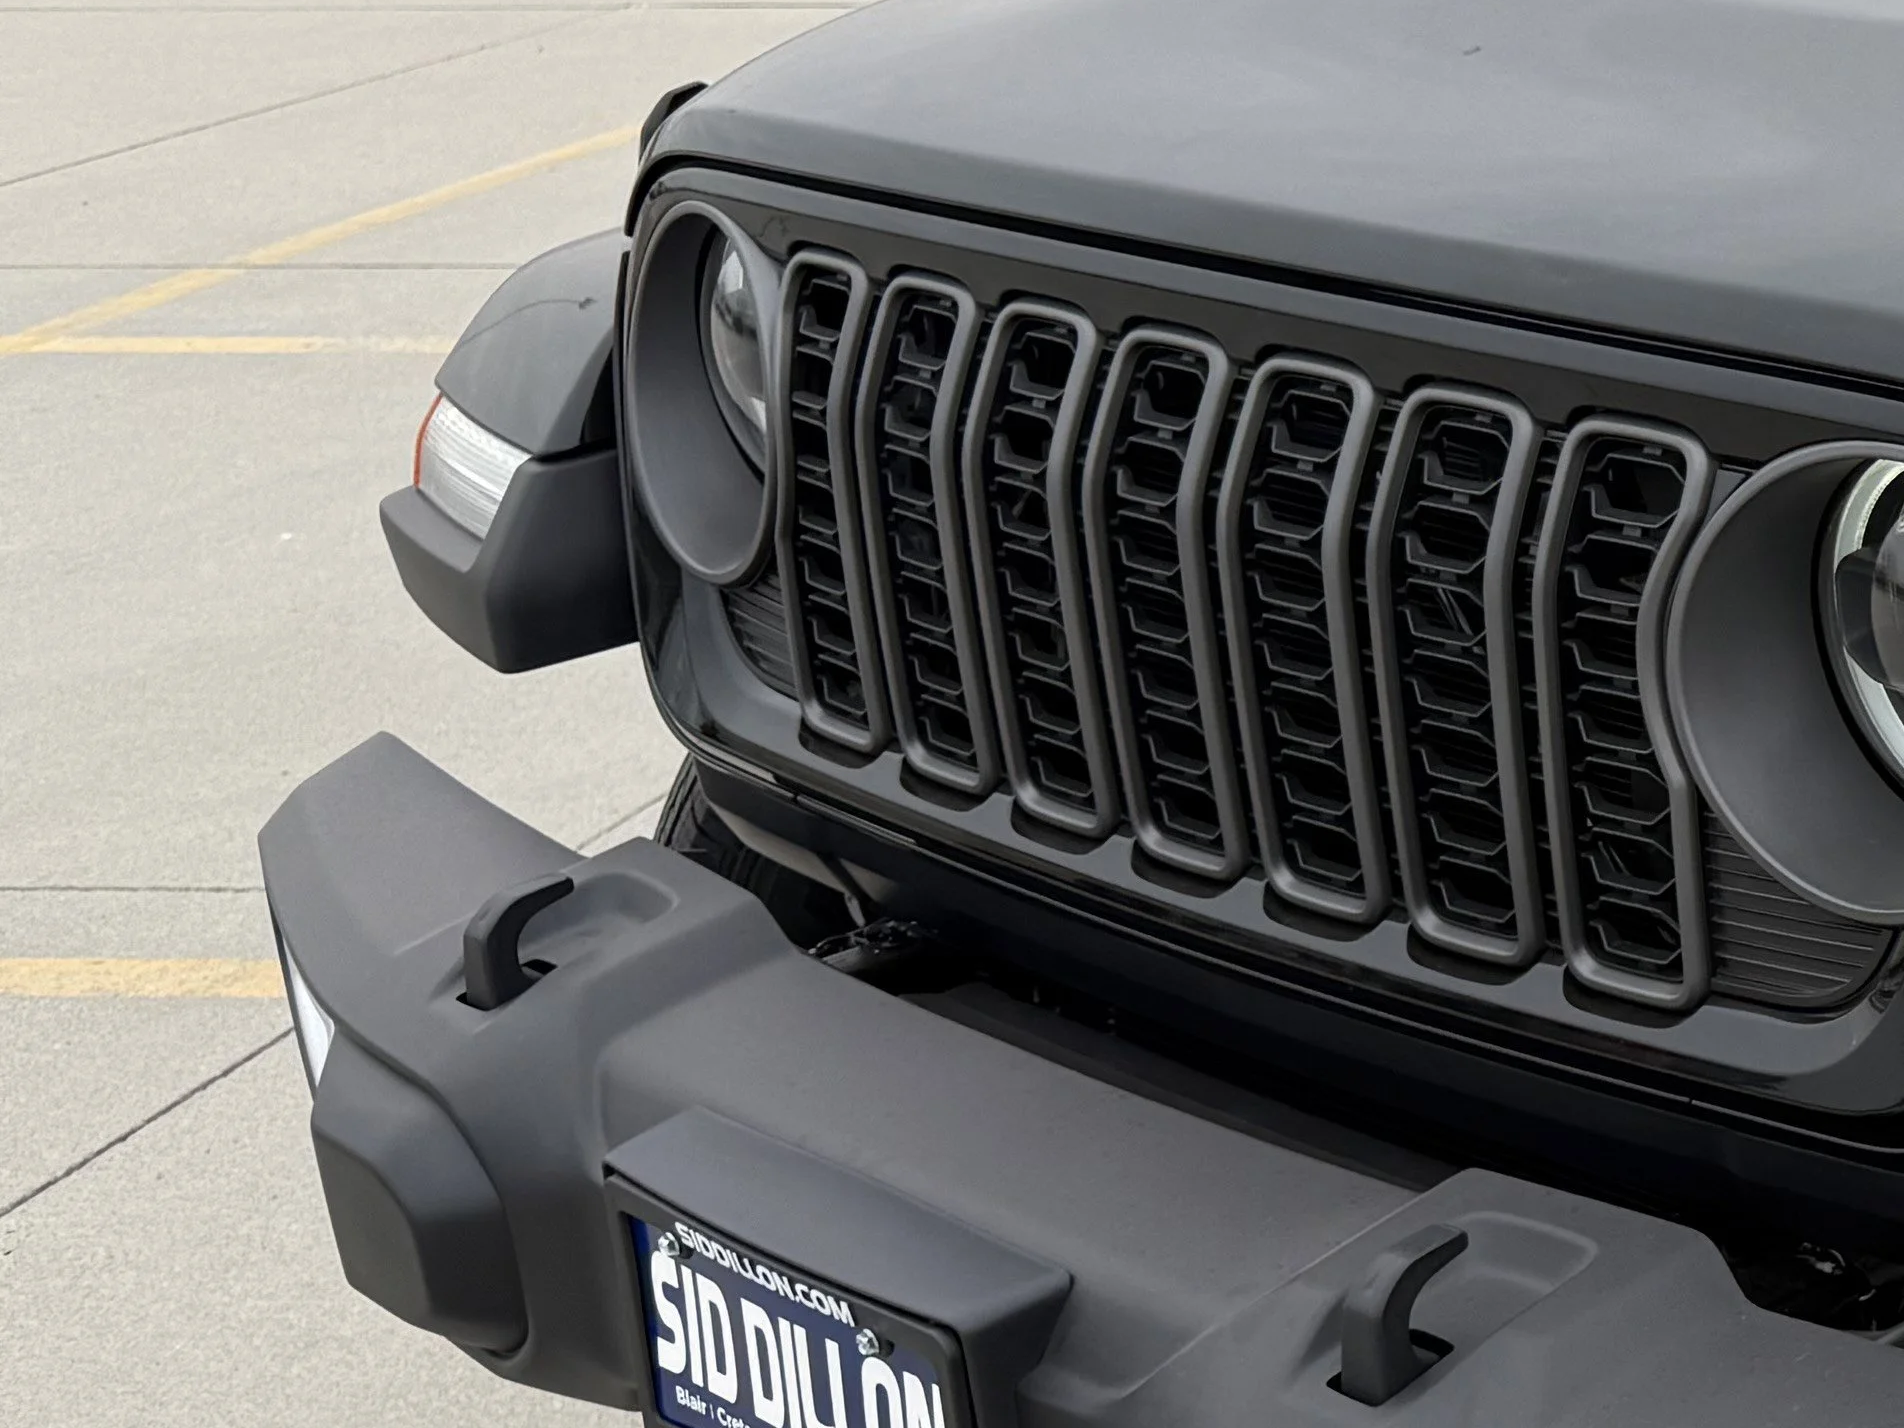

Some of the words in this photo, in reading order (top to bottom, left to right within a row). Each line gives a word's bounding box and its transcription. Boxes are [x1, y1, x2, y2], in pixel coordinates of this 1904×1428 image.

[651, 1250, 738, 1404] SID
[674, 1222, 855, 1328] SIDDILLON.COM
[675, 1385, 708, 1416] Blair
